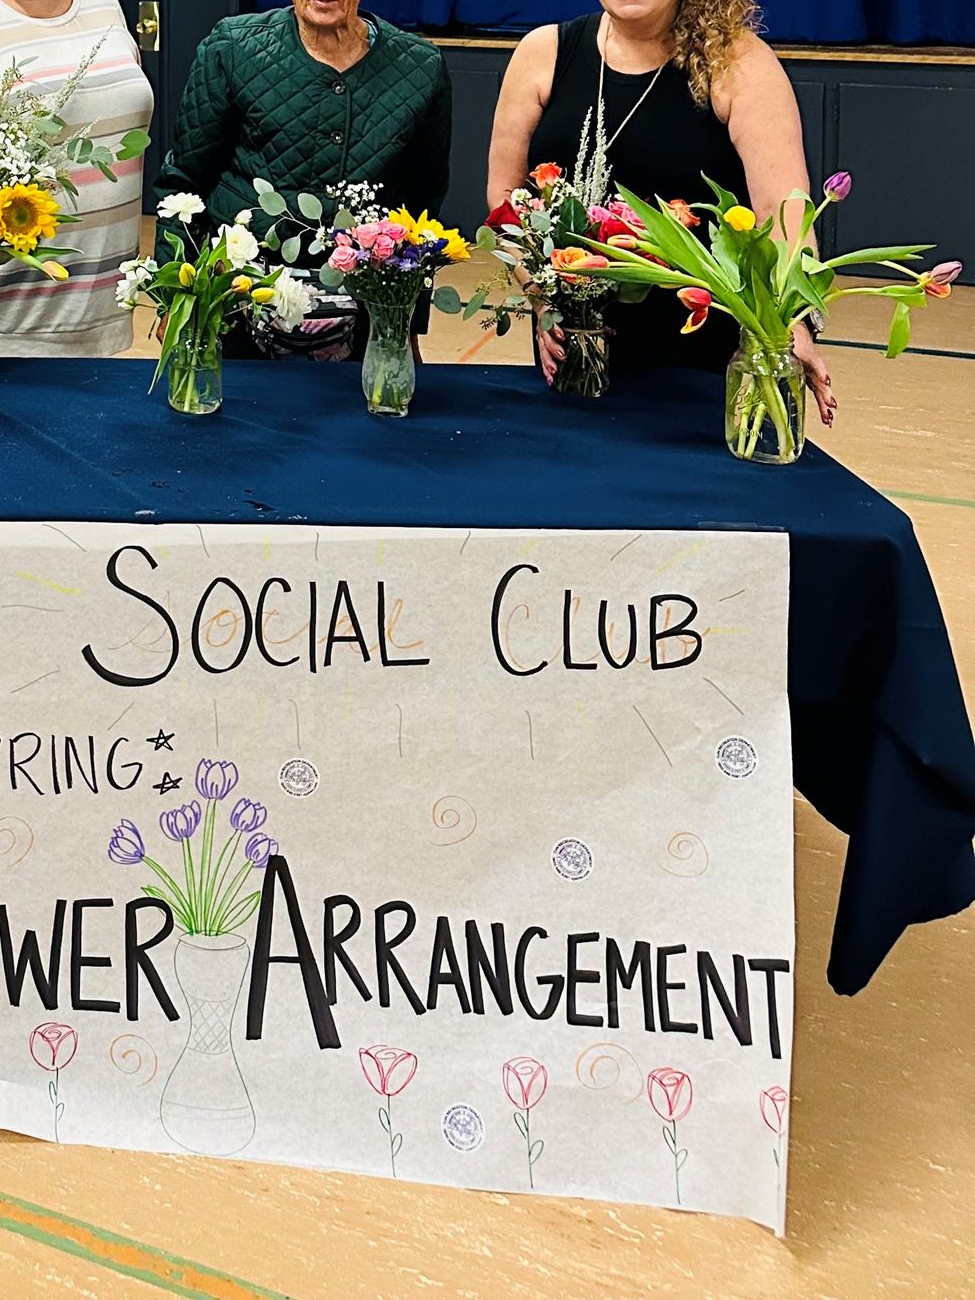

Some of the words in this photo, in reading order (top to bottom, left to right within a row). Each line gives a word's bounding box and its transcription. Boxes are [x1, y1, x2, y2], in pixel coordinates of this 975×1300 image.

[81, 545, 431, 688] SOCIAL
[491, 563, 703, 677] CLUB
[245, 854, 791, 1061] ARRANGEMENT
